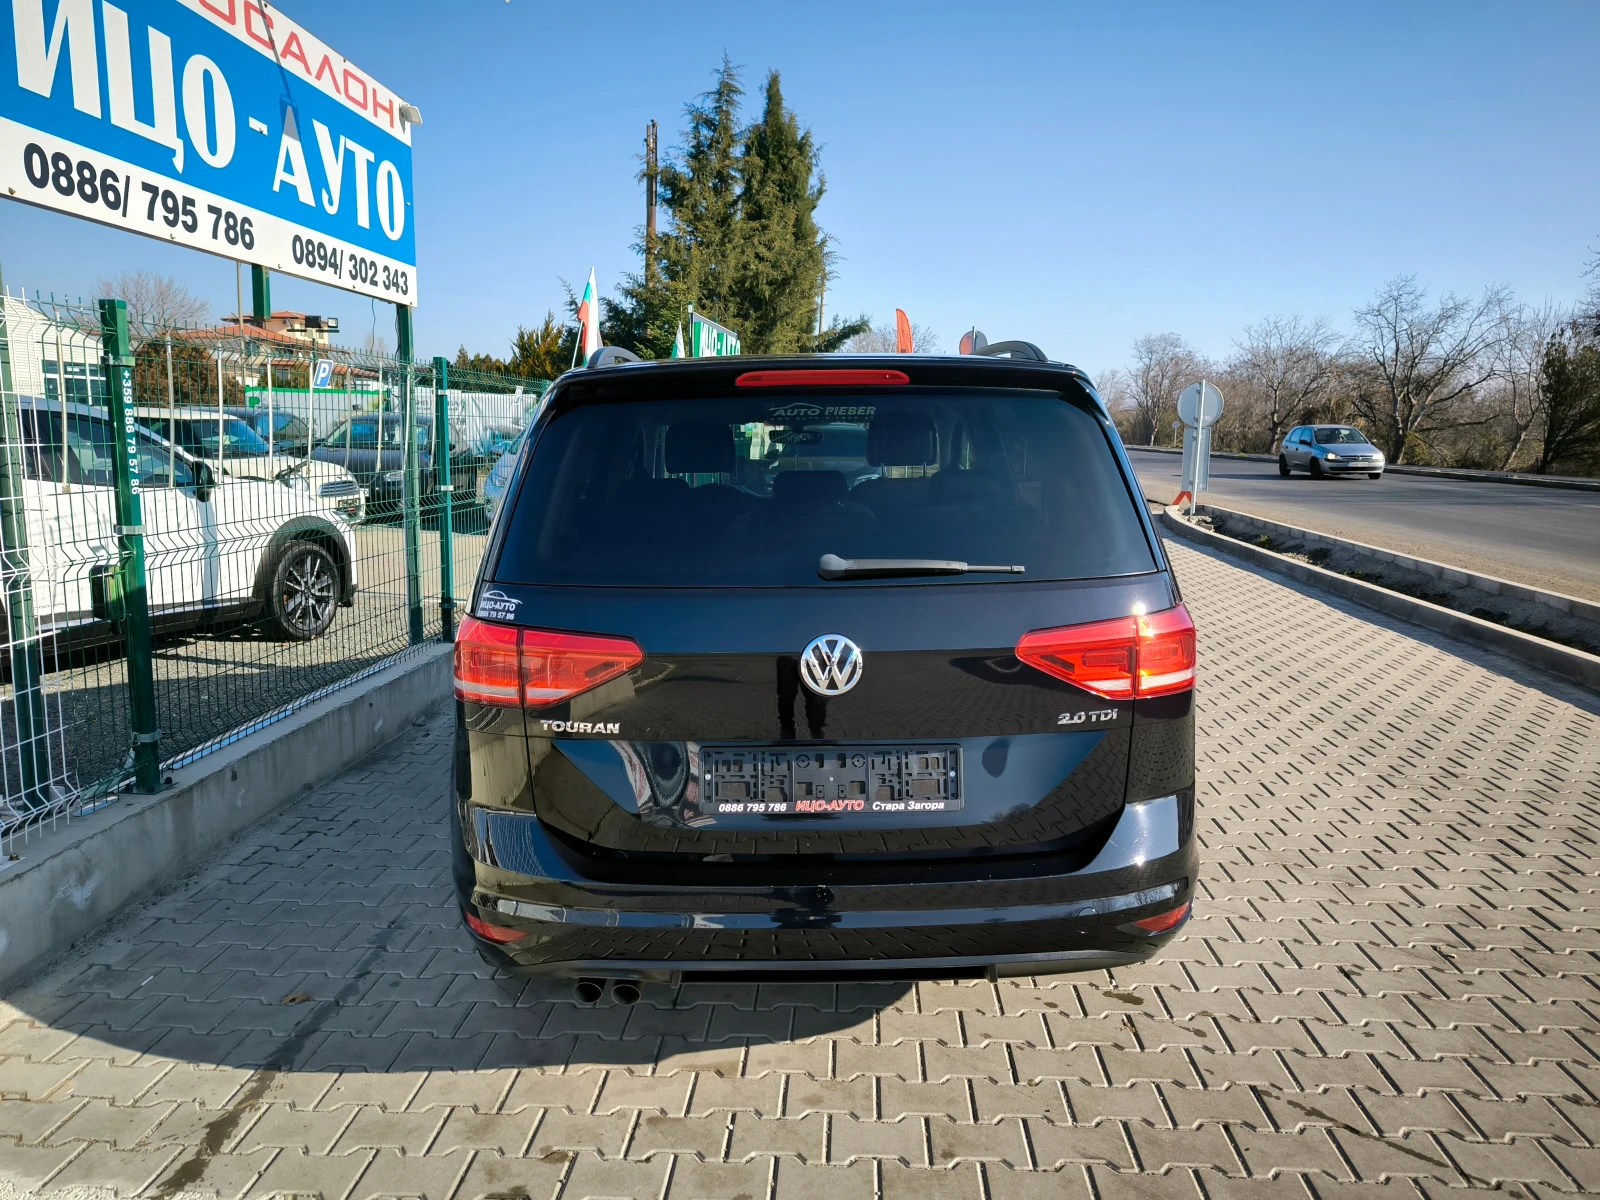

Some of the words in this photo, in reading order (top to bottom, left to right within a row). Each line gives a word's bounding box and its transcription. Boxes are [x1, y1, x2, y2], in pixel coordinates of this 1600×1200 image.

[23, 143, 130, 217] 0886/
[141, 183, 198, 234] 795
[207, 204, 254, 250] 786
[292, 235, 343, 279] 0894/
[348, 253, 379, 287] 302
[383, 264, 409, 295] 343
[123, 370, 132, 404] +359
[773, 408, 820, 416] AUTO
[824, 406, 876, 416] PIEBER
[124, 408, 135, 433] 886
[127, 437, 137, 454] 79
[131, 479, 140, 495] 86
[1088, 708, 1119, 722] TDI
[540, 719, 621, 734] TOURAN
[718, 803, 744, 812] 0886
[746, 803, 766, 812] 795
[767, 803, 787, 812] 786
[795, 799, 864, 812] ИЦО-АУТО
[872, 801, 904, 812] Стара
[907, 800, 945, 812] Загора
